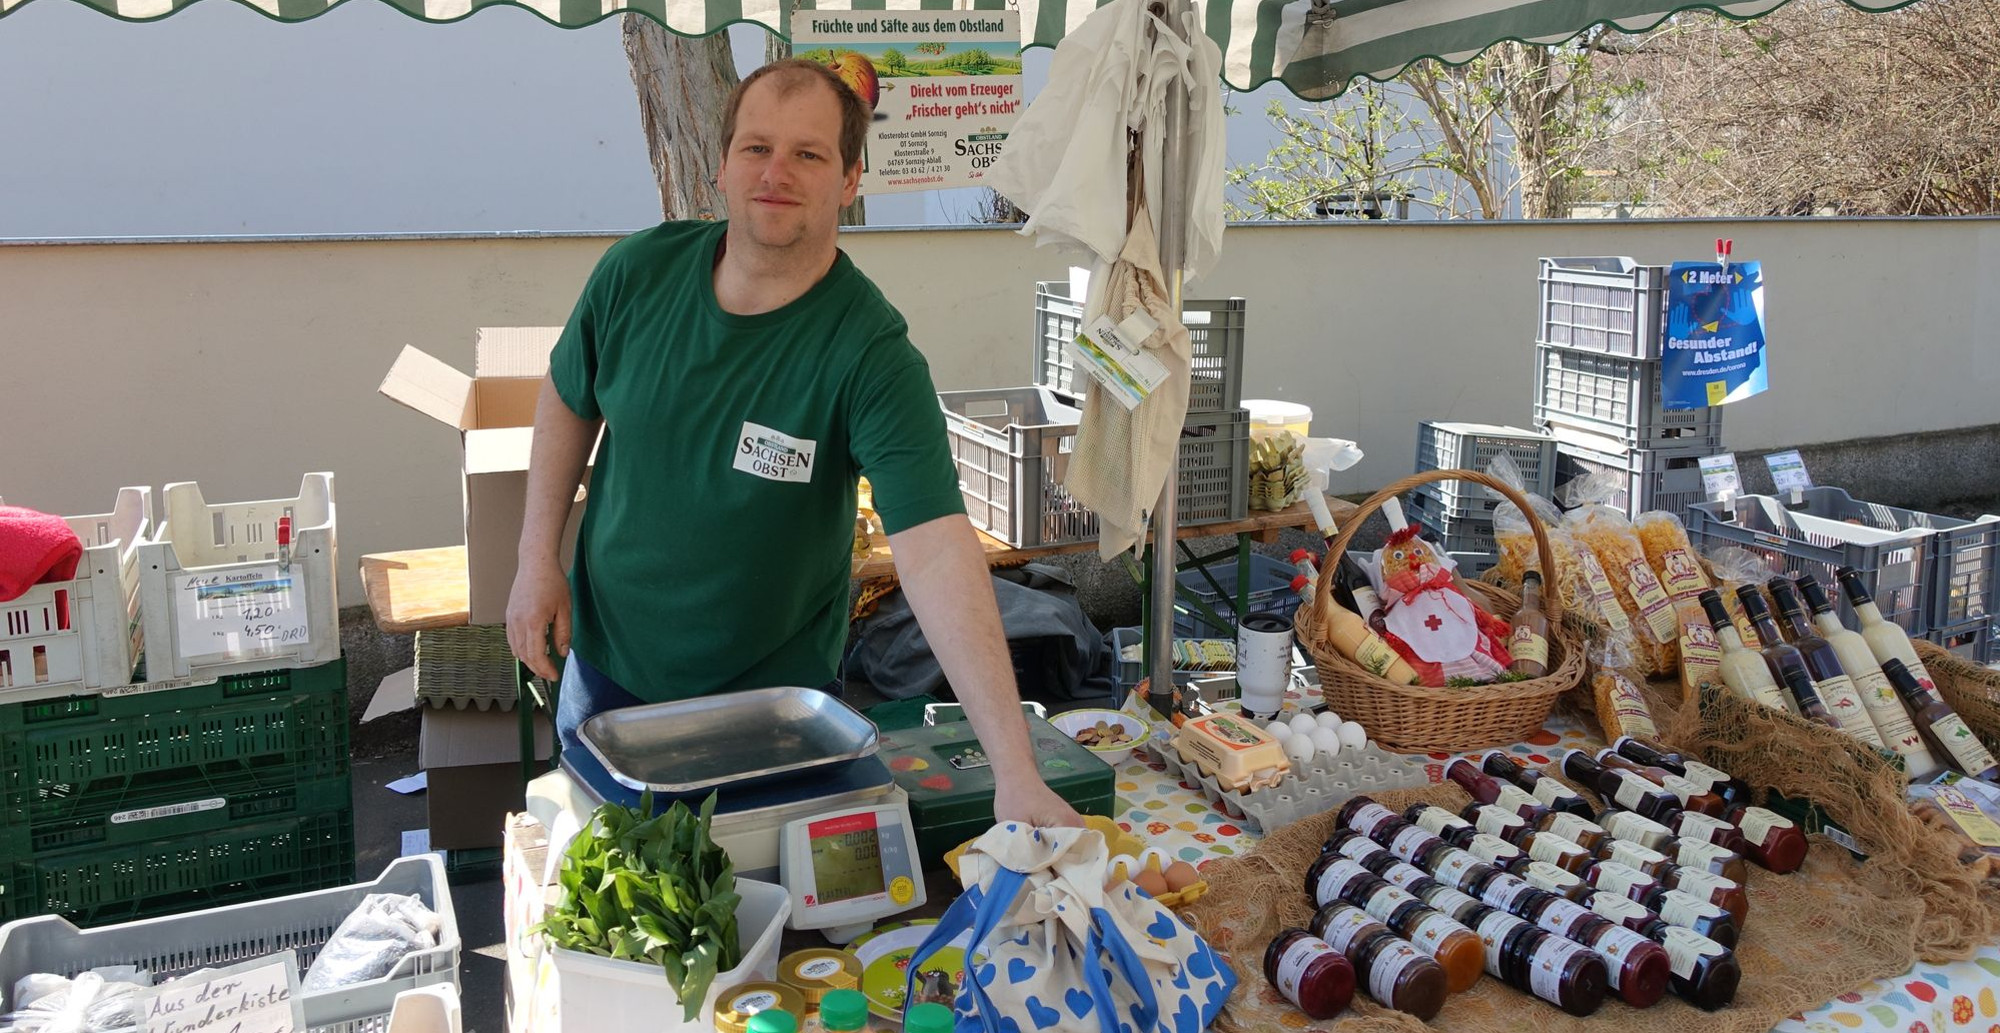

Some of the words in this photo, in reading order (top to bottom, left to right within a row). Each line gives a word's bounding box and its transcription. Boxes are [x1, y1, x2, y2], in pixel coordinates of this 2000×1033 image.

[812, 18, 853, 33] Früchte
[857, 19, 877, 33] und
[881, 19, 908, 33] Säfte
[912, 22, 930, 32] aus
[934, 19, 956, 32] dem
[959, 18, 1004, 33] Obstland
[910, 83, 943, 98] Direkt
[945, 85, 967, 97] vom
[970, 84, 1014, 98] Erzeuger
[878, 131, 910, 140] Klosterobst
[911, 130, 926, 138] GmbH
[928, 129, 948, 138] Sornzig
[908, 140, 928, 148] Sornzig
[894, 148, 929, 157] Klosterstraße
[879, 168, 901, 176] Telefon:
[887, 175, 944, 185] www.sachsenobst.de
[1688, 271, 1697, 284] 2
[1700, 271, 1733, 284] Meter
[1668, 336, 1732, 350] Gesunder
[1694, 341, 1758, 364] Abstand!
[1682, 362, 1747, 376] www.dresden.de/corona
[740, 436, 811, 468] SACHSEN
[752, 459, 788, 478] OBST
[225, 573, 263, 582] Kartoffeln
[242, 607, 273, 621] 1,20
[244, 624, 275, 637] 4,50
[150, 995, 185, 1018] Aus
[196, 981, 242, 1004] der
